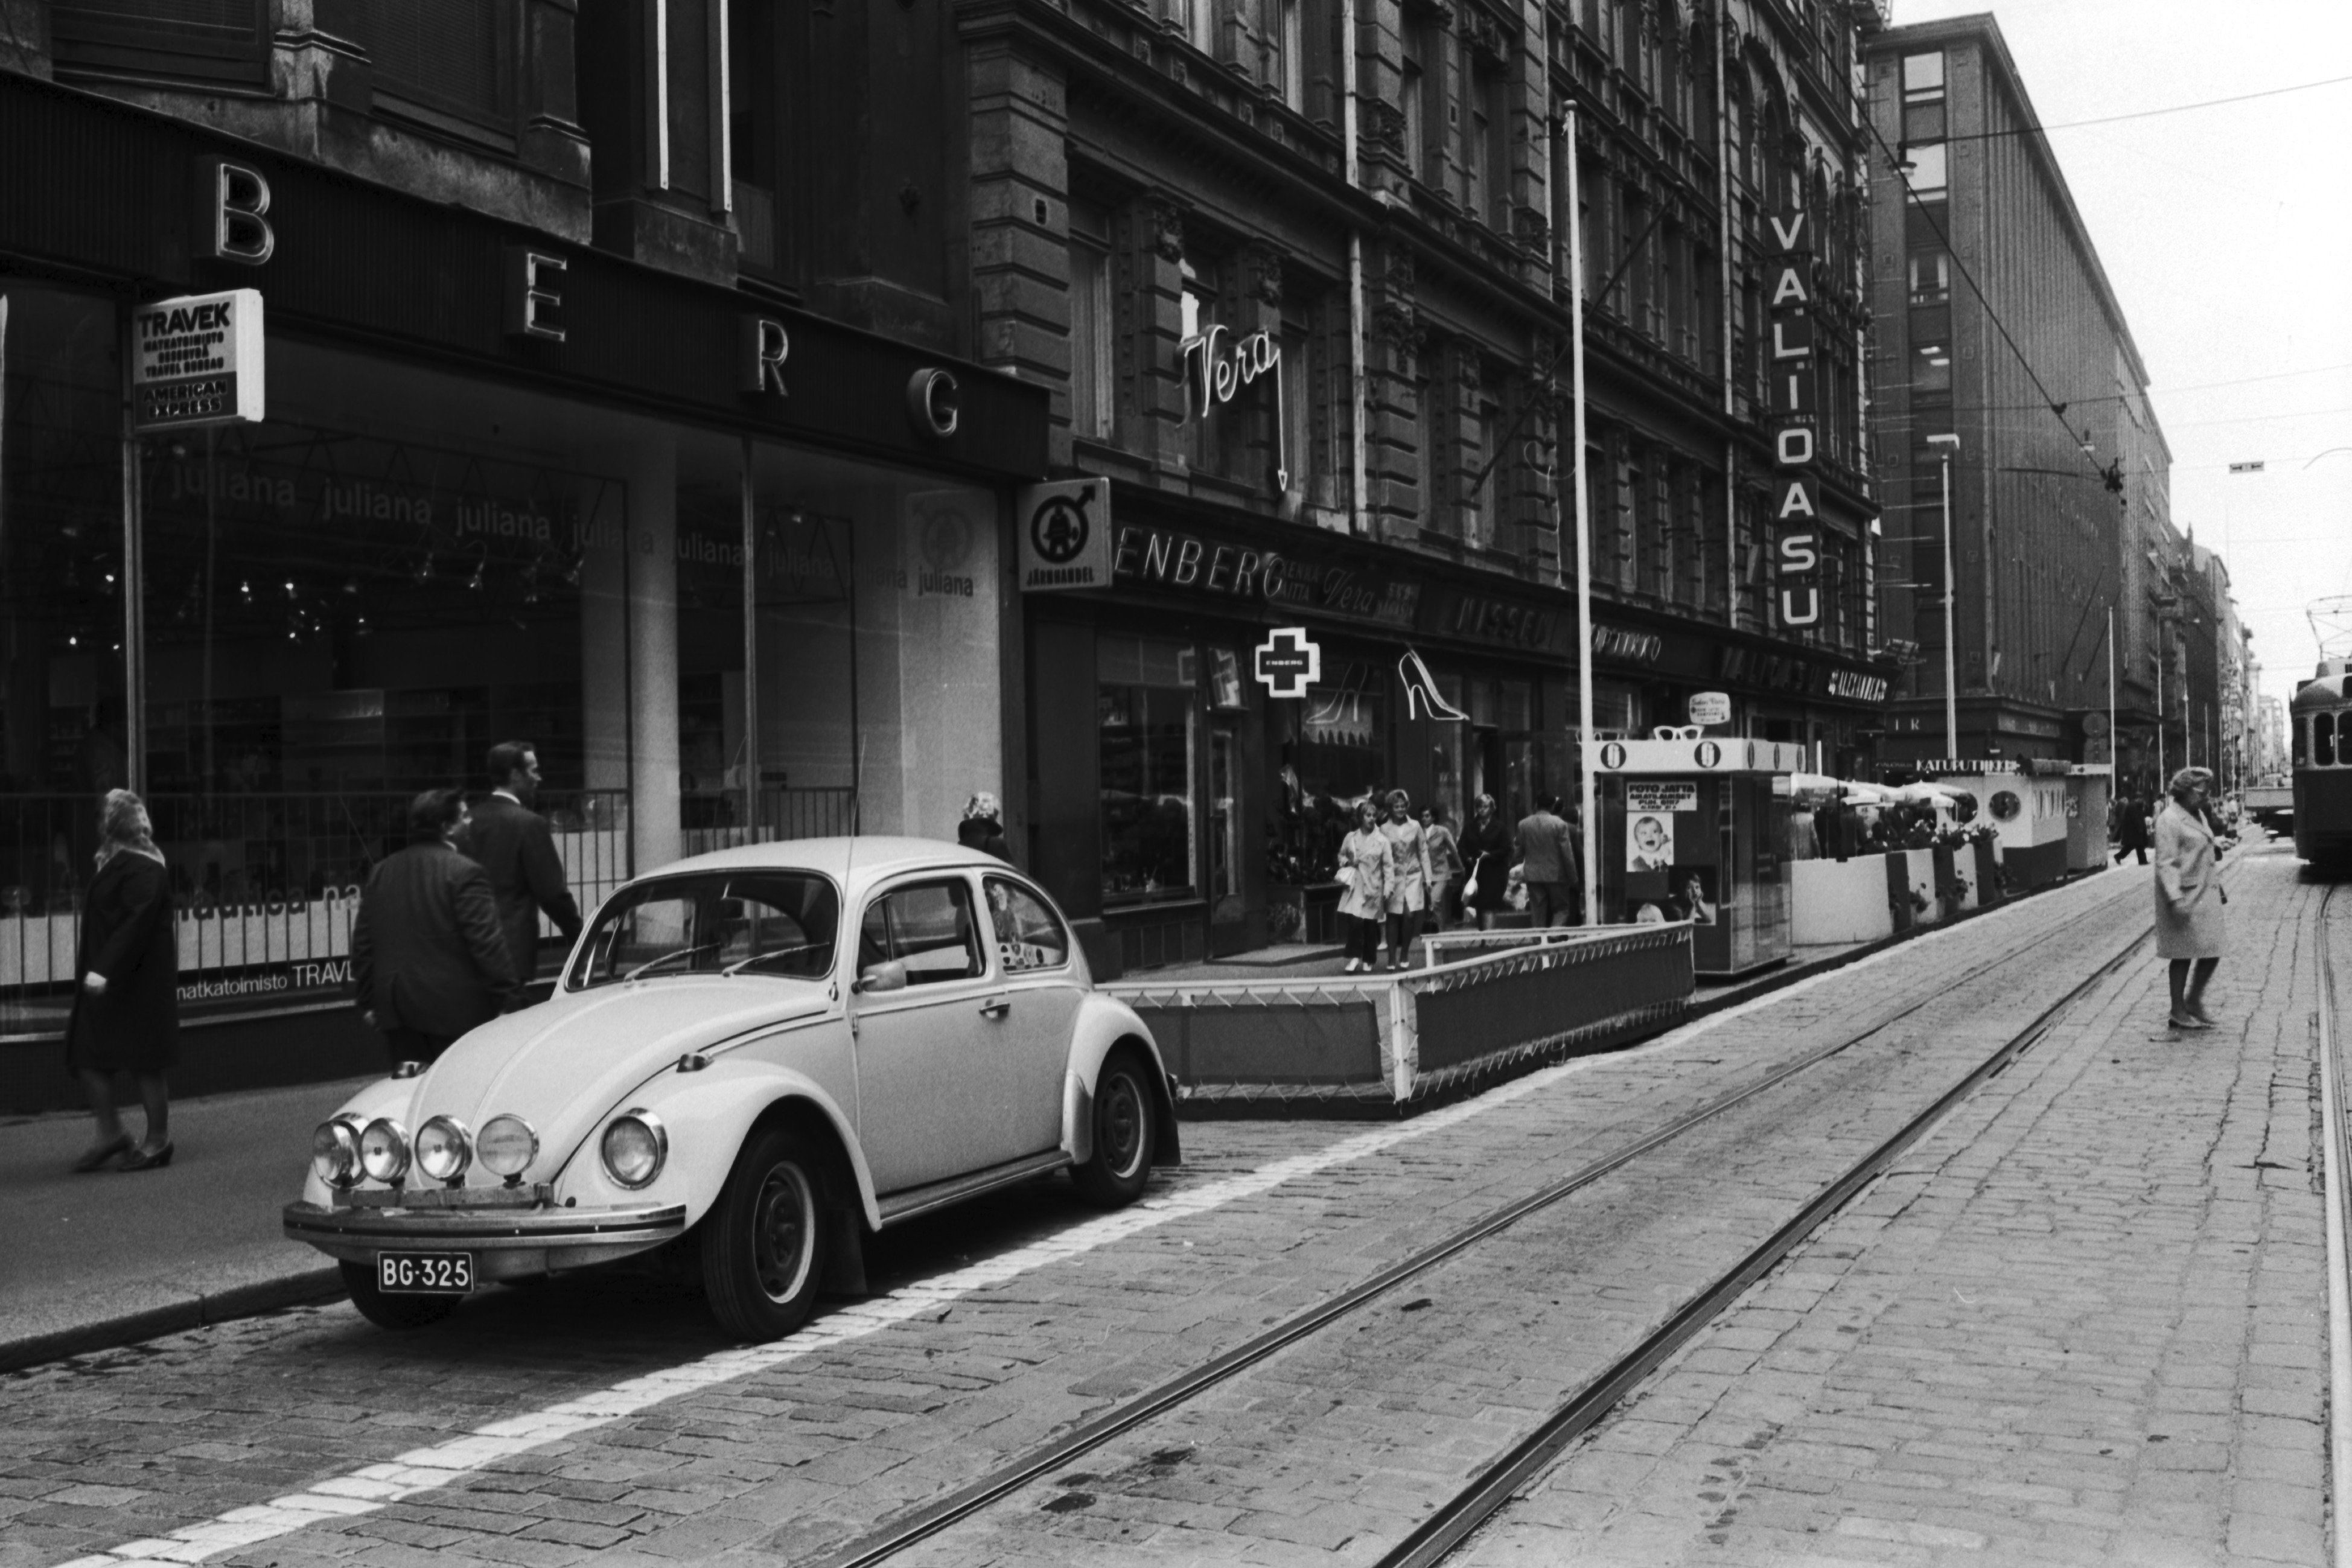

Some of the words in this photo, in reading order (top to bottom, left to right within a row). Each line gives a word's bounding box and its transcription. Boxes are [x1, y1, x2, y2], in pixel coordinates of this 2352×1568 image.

[138, 302, 230, 337] TRAVEK
[145, 363, 181, 378] TRAVEL
[1184, 324, 1281, 418] Vera
[144, 380, 226, 402] AMERICAN
[148, 397, 221, 418] EXPRESS
[1770, 212, 1817, 624] VALIOASU
[322, 477, 432, 523] juliana
[456, 495, 551, 541] juliana
[1027, 566, 1095, 587] JÄRNHANDEL
[1114, 526, 1284, 598] ENBERG
[918, 566, 974, 597] juliana
[1323, 566, 1375, 613] Vera
[1629, 784, 1660, 793] FOTO
[1662, 784, 1695, 793] JATTA
[383, 1258, 469, 1287] BG-325
